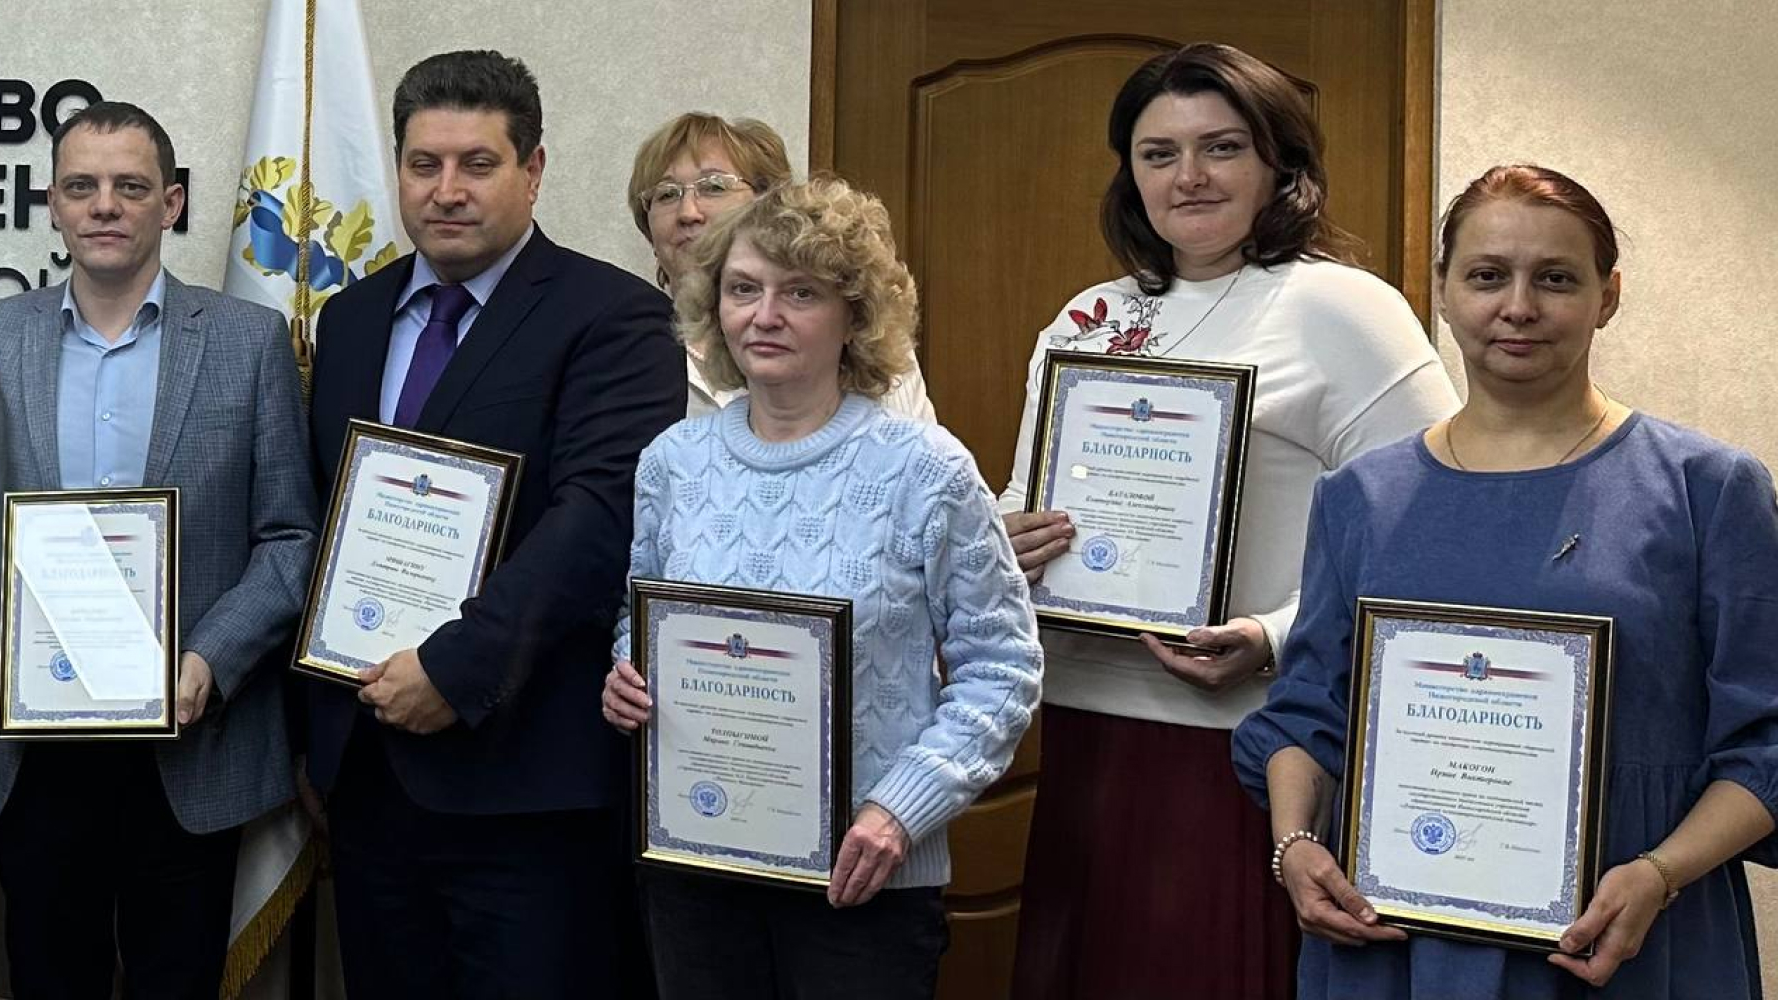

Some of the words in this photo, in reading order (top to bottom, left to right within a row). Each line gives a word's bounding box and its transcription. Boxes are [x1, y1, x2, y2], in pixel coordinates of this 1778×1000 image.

[1082, 441, 1192, 463] БЛАГОДАРНОСТЬ
[367, 508, 460, 539] БЛАГОДАРНОСТЬ
[682, 678, 796, 703] БЛАГОДАРНОСТЬ
[1406, 702, 1543, 730] БЛАГОДАРНОСТЬ
